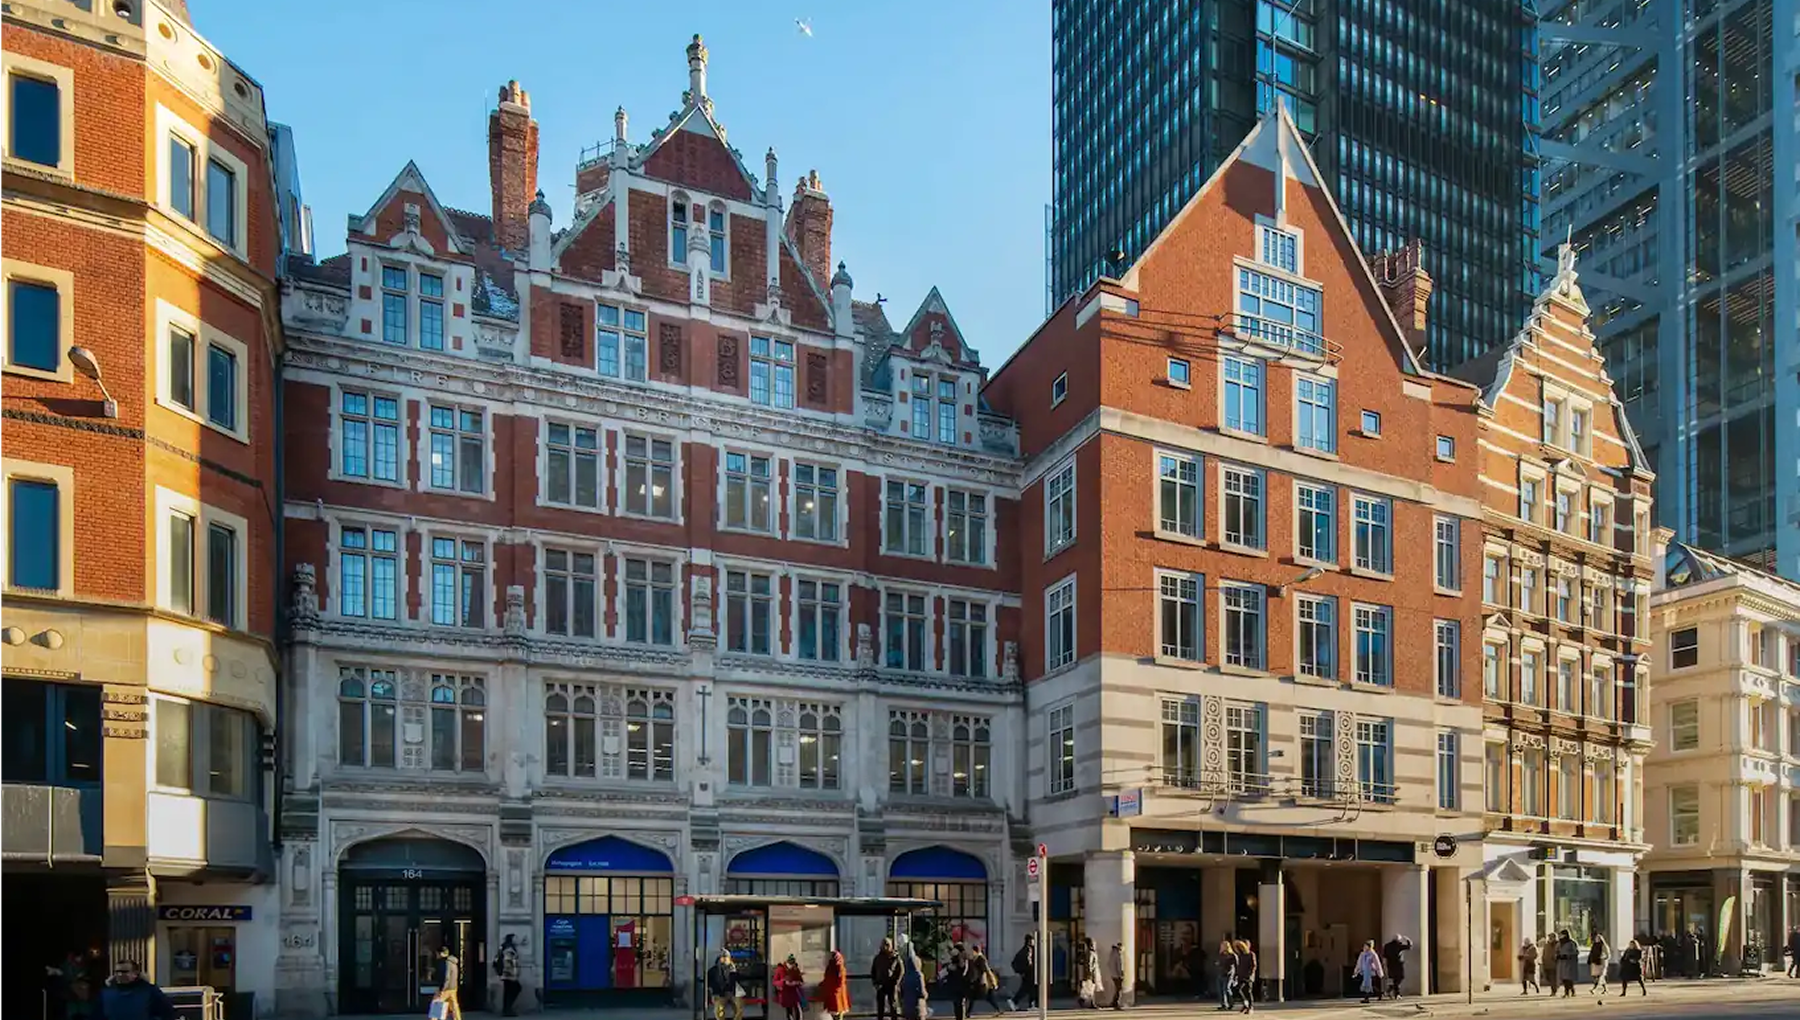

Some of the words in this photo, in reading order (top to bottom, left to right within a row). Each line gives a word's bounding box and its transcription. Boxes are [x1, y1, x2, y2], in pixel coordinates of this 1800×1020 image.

[367, 362, 449, 386] FIRE
[636, 406, 762, 438] BRIGADE
[883, 452, 996, 481] STATION
[402, 869, 422, 879] 164
[165, 908, 233, 919] CORAL
[284, 934, 313, 949] 164
